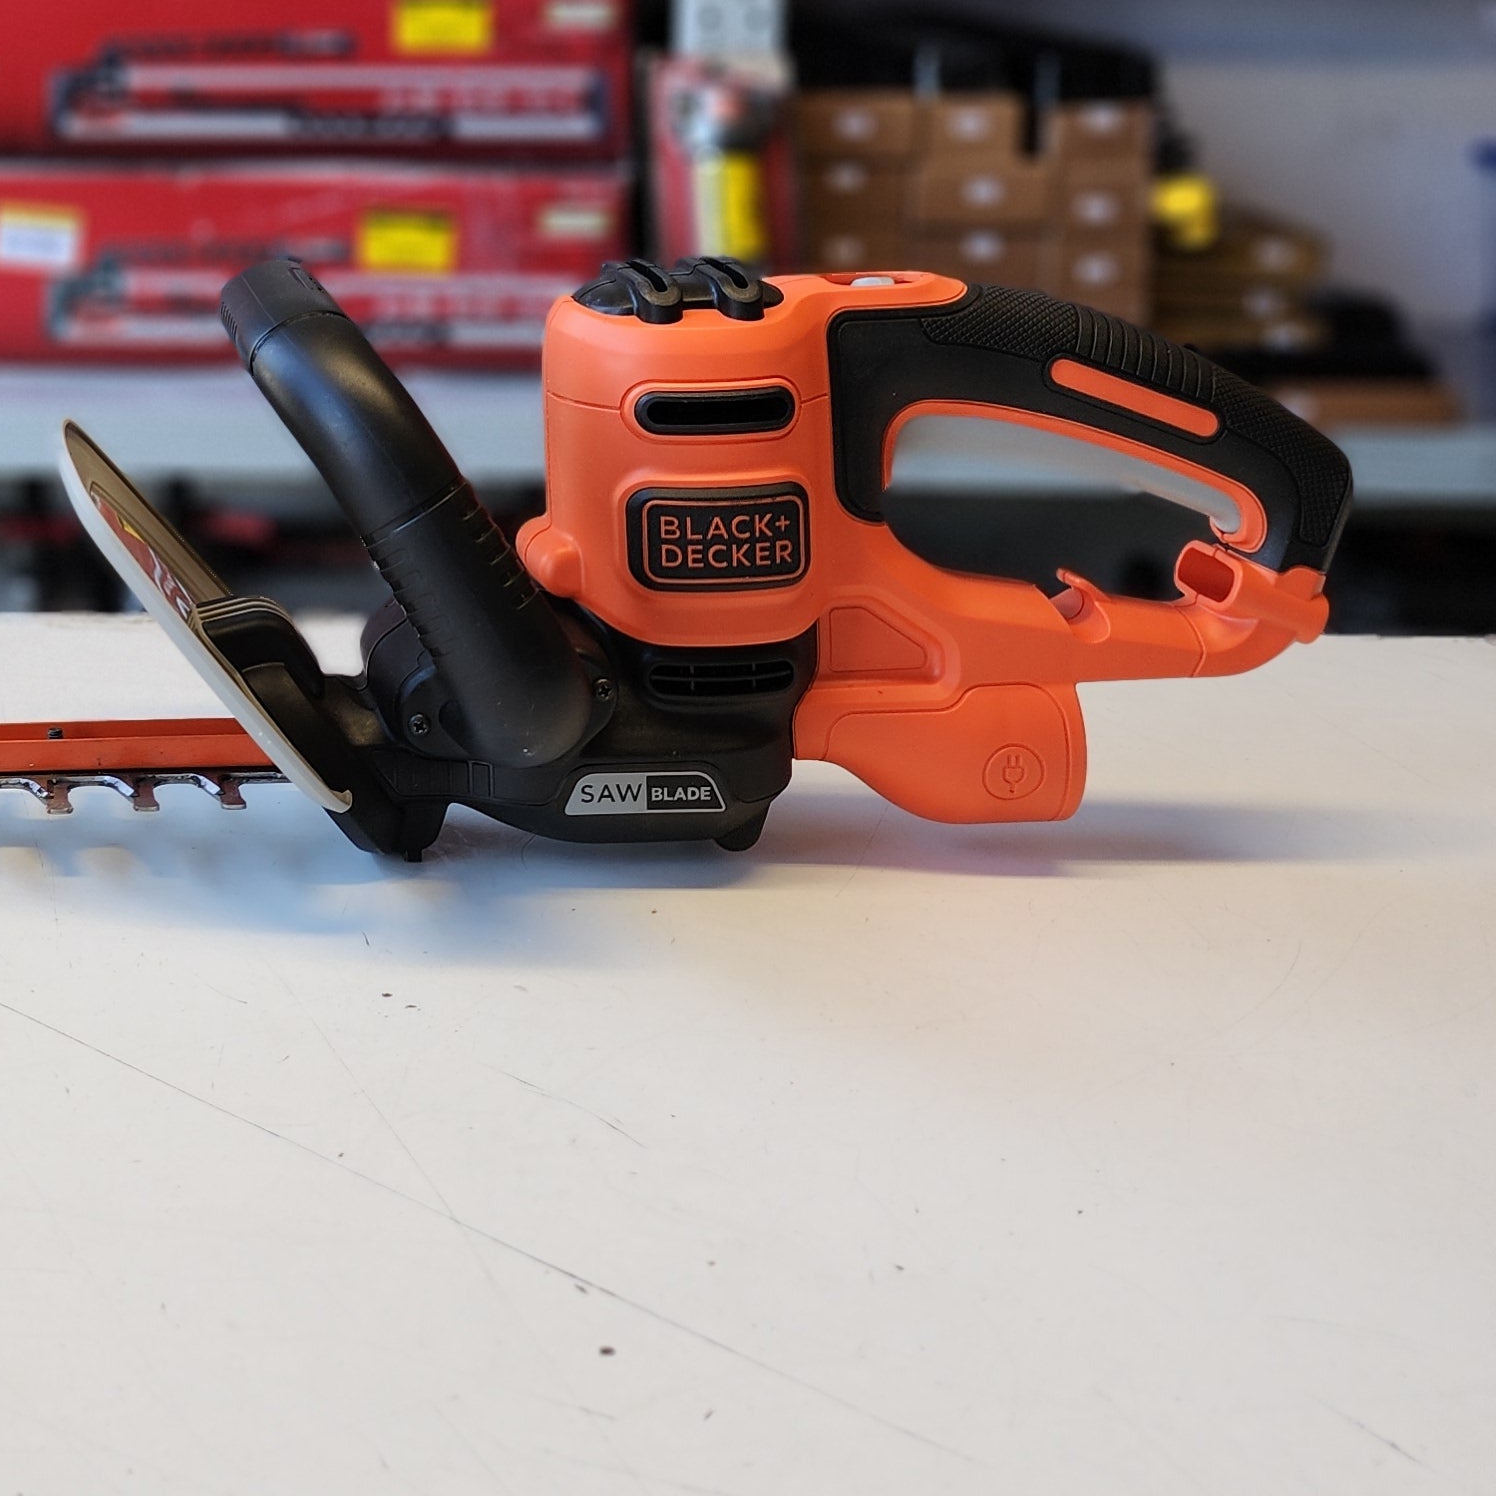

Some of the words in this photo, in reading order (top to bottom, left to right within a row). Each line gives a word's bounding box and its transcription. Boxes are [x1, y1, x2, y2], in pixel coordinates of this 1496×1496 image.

[660, 513, 791, 540] BLACK+
[661, 540, 793, 568] DECKER
[581, 784, 643, 803] SAW
[651, 787, 711, 801] BLADE
